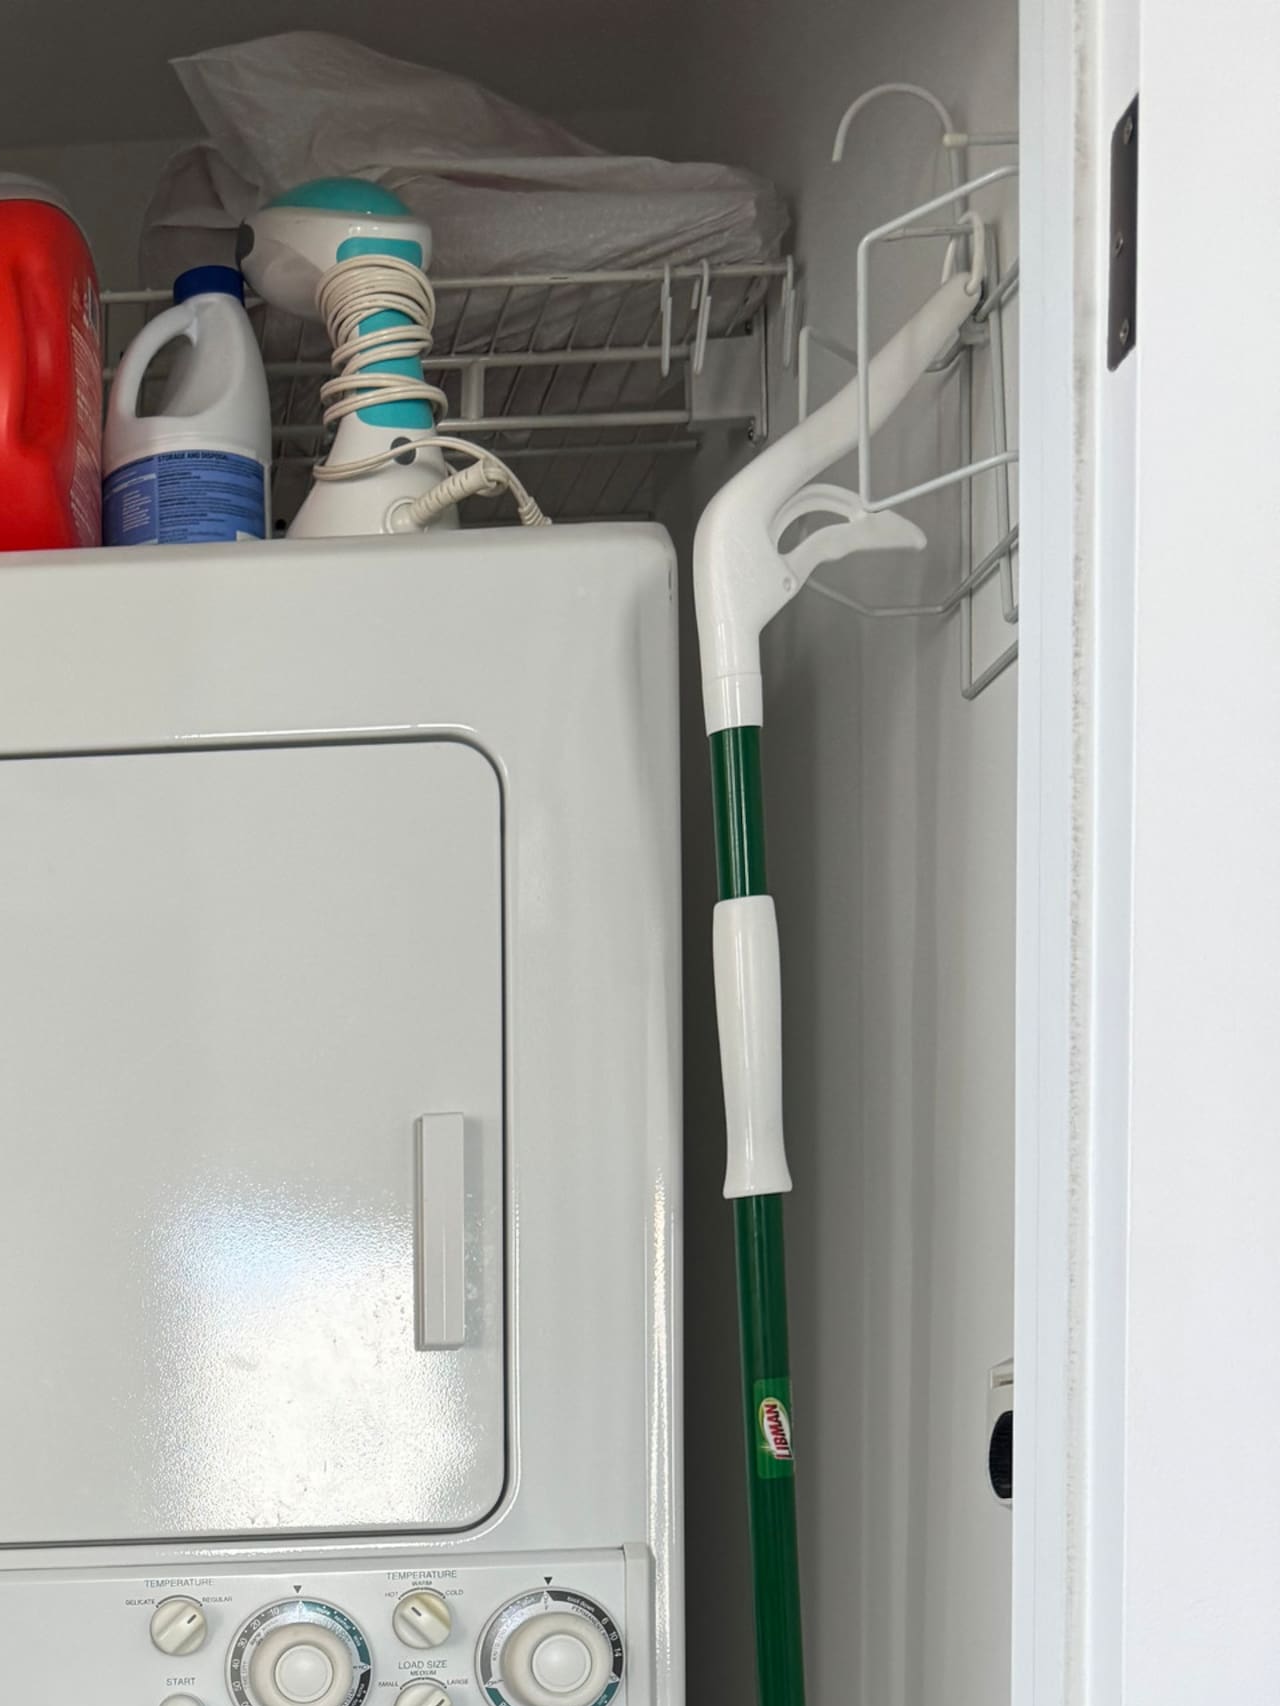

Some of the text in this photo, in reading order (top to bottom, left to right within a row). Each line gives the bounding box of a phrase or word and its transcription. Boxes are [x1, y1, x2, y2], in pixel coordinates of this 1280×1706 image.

[764, 1403, 792, 1458] LIBMAN
[386, 1570, 457, 1580] TEMPERATURE
[144, 1578, 214, 1588] TEMPERATURE
[398, 1659, 448, 1670] LOAD SIZE
[166, 1677, 196, 1686] START
